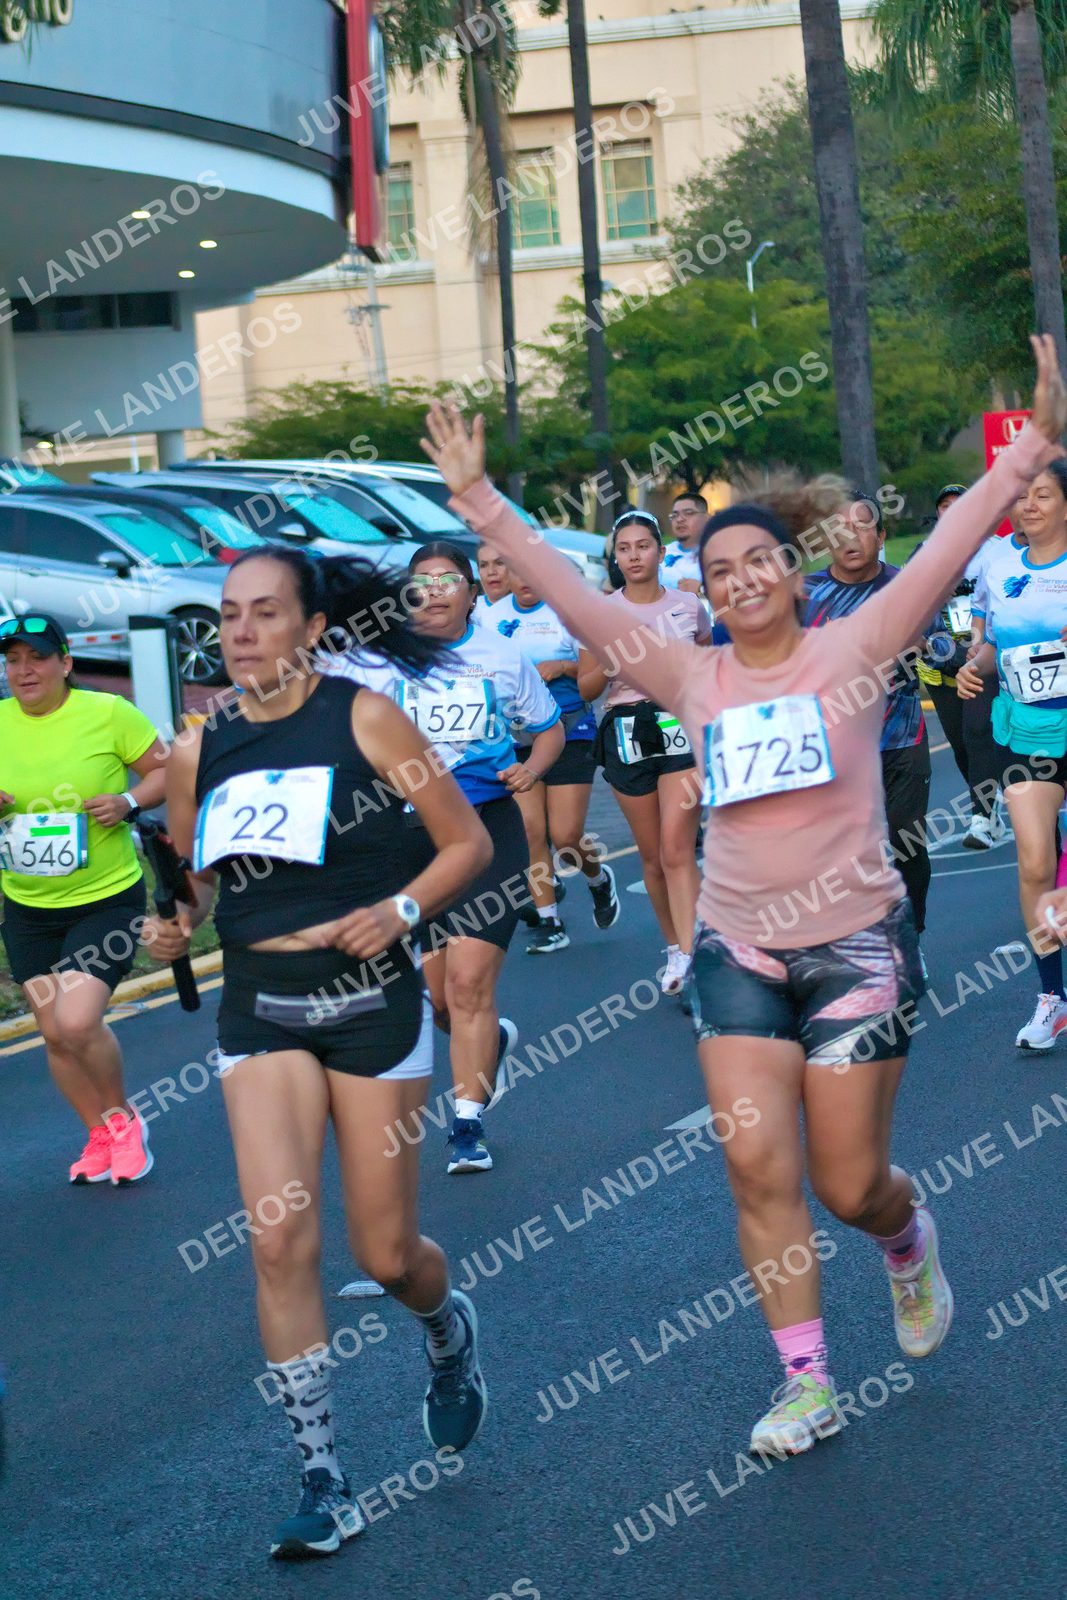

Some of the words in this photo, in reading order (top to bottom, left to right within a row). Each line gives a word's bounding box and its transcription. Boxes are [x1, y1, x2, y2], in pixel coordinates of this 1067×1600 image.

[1013, 664, 1060, 695] 187
[410, 703, 486, 733] 1527
[716, 733, 822, 788] 1725
[230, 803, 289, 843] 22
[4, 839, 75, 868] 1546
